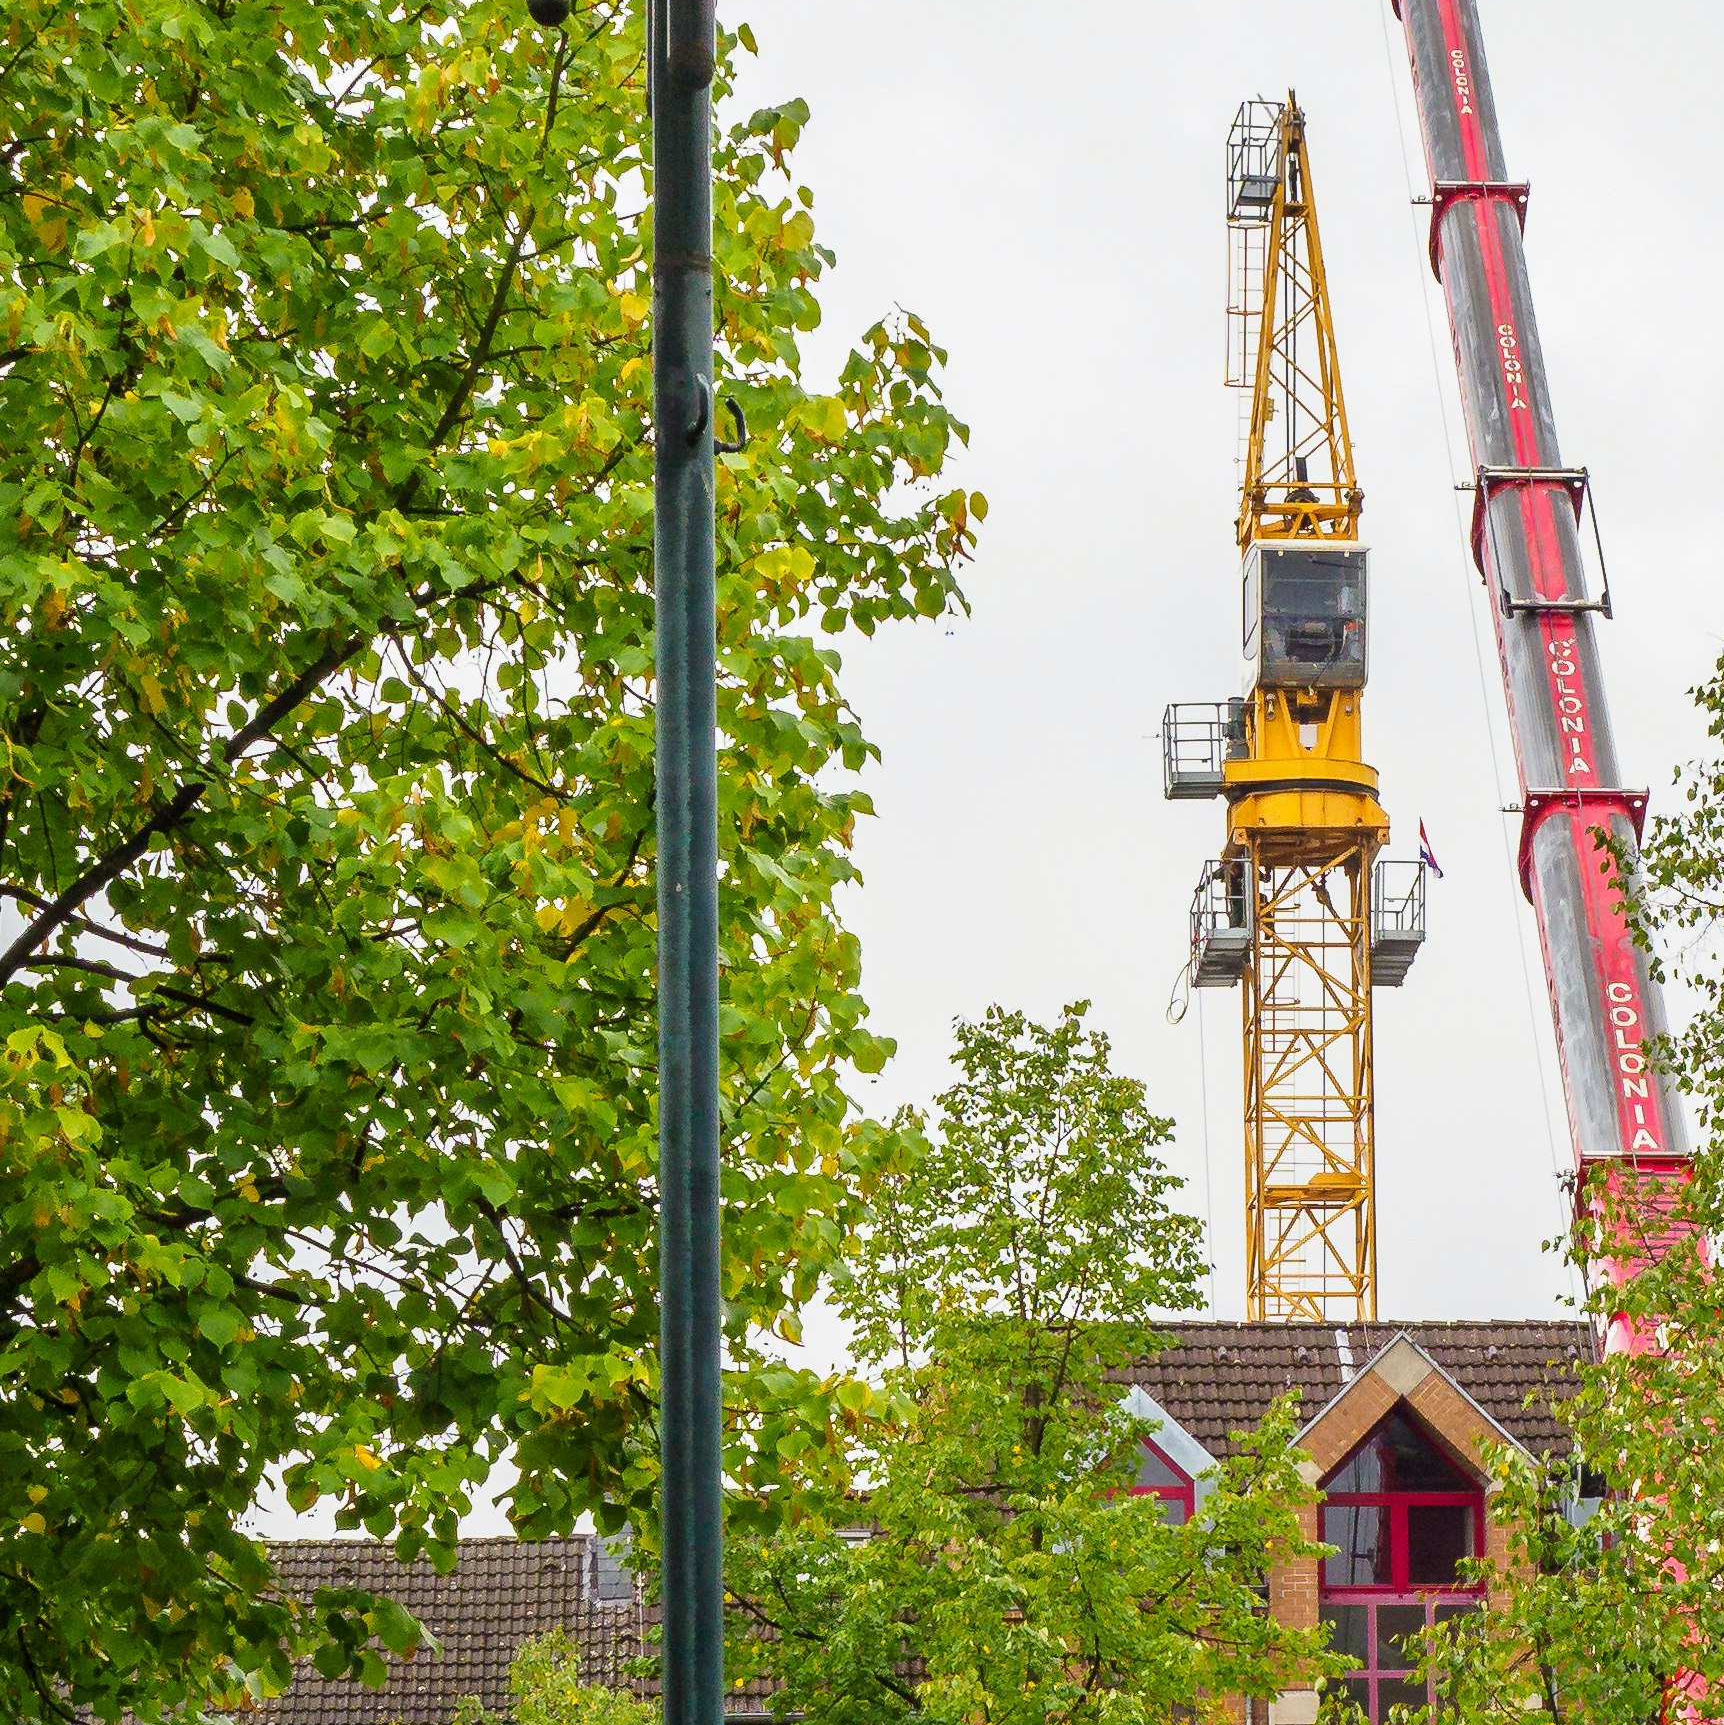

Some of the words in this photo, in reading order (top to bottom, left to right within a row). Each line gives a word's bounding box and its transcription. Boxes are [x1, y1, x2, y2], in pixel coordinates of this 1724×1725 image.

[1449, 49, 1473, 115] COLONIA
[1497, 323, 1527, 409] COLONIA
[1548, 639, 1591, 774] COLONIA
[1606, 982, 1659, 1150] COLONIA
